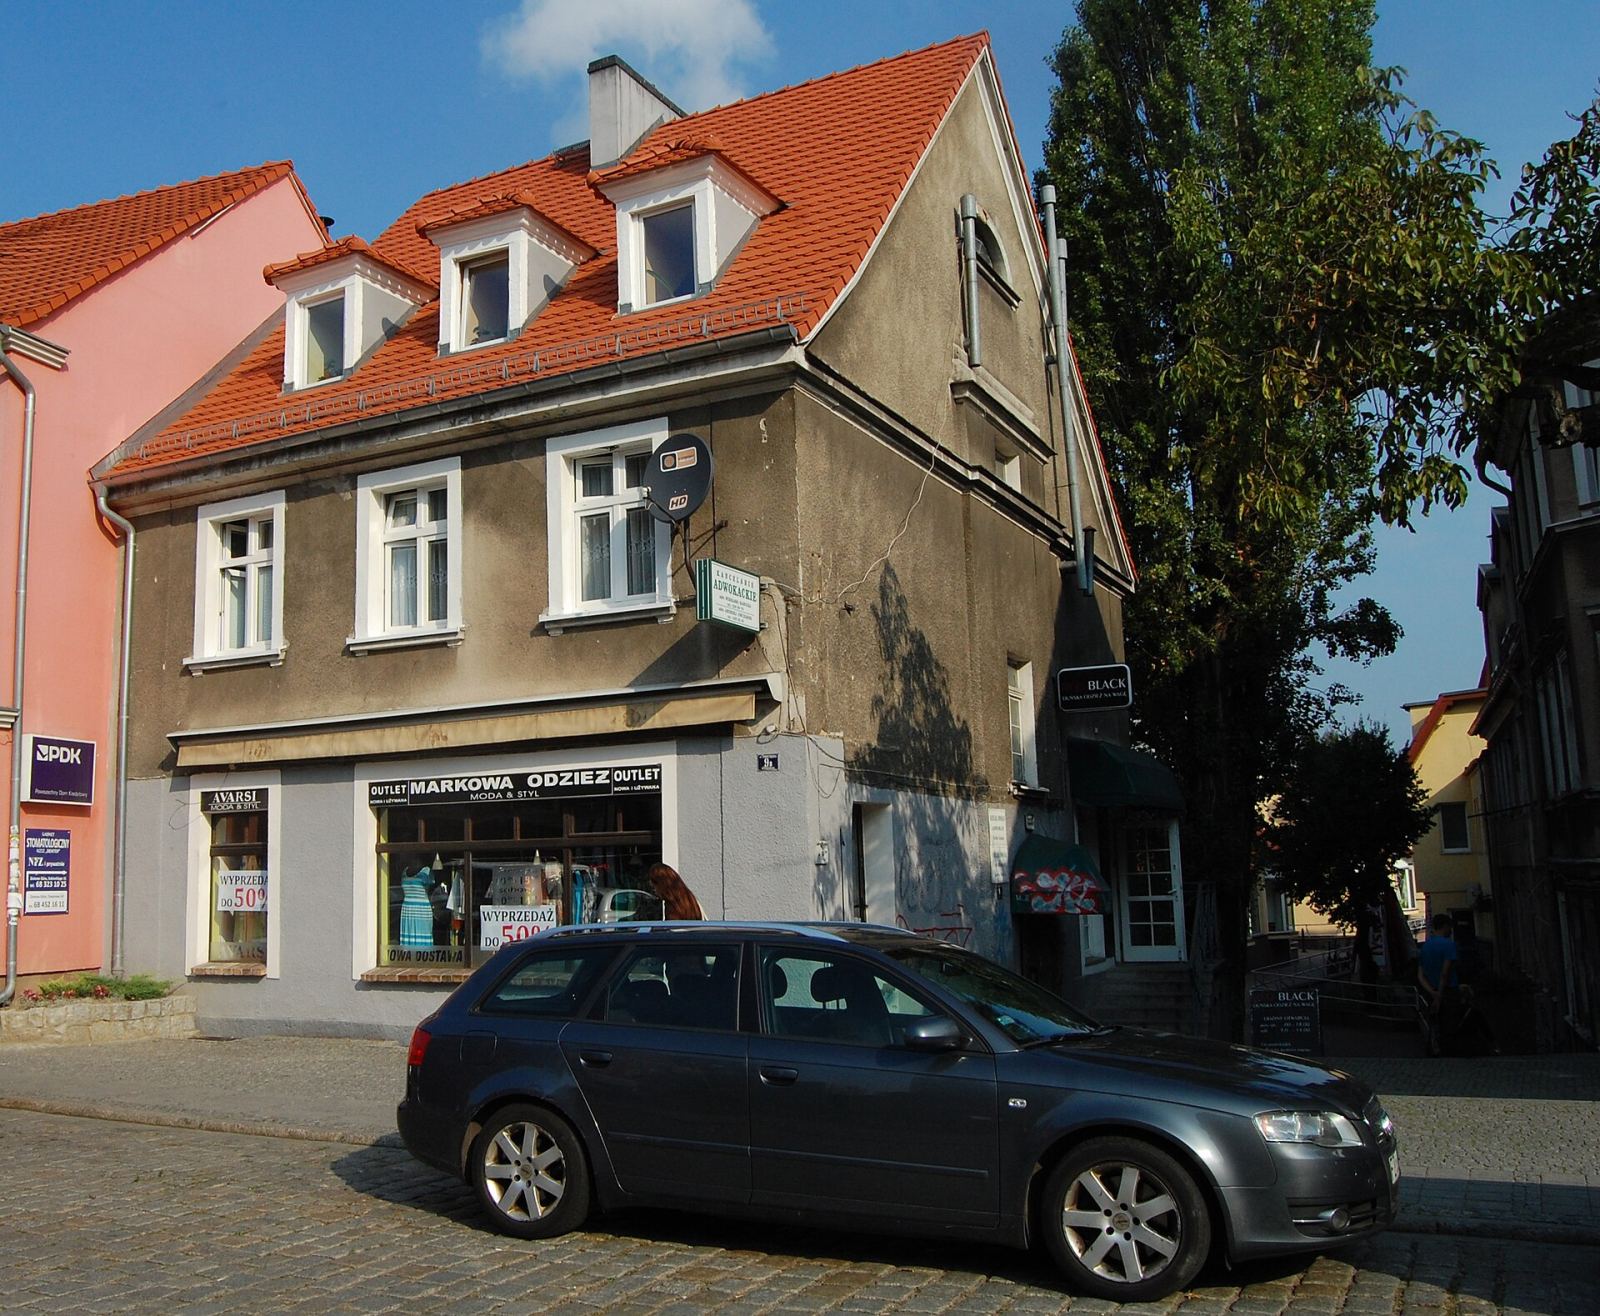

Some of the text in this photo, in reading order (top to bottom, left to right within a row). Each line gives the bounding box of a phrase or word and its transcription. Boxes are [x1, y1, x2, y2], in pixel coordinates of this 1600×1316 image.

[671, 497, 687, 509] HD
[713, 579, 757, 602] ADWOKACKIE
[1088, 679, 1127, 691] BLACK
[49, 745, 81, 764] PDK
[613, 768, 660, 782] OUTLET
[371, 784, 407, 796] OUTLET
[410, 776, 514, 795] MARKOWA
[212, 790, 257, 803] AVARSI
[470, 792, 503, 801] MODA
[517, 790, 540, 798] STYL
[210, 803, 234, 811] MODA
[243, 802, 258, 810] STYL
[220, 875, 268, 886] WYPRZEDA
[221, 898, 233, 908] DO
[482, 908, 554, 922] WYPRZEDAŻ
[485, 937, 499, 947] DO
[387, 949, 463, 962] OWA DOSTAWA
[1278, 992, 1314, 1001] BLACK
